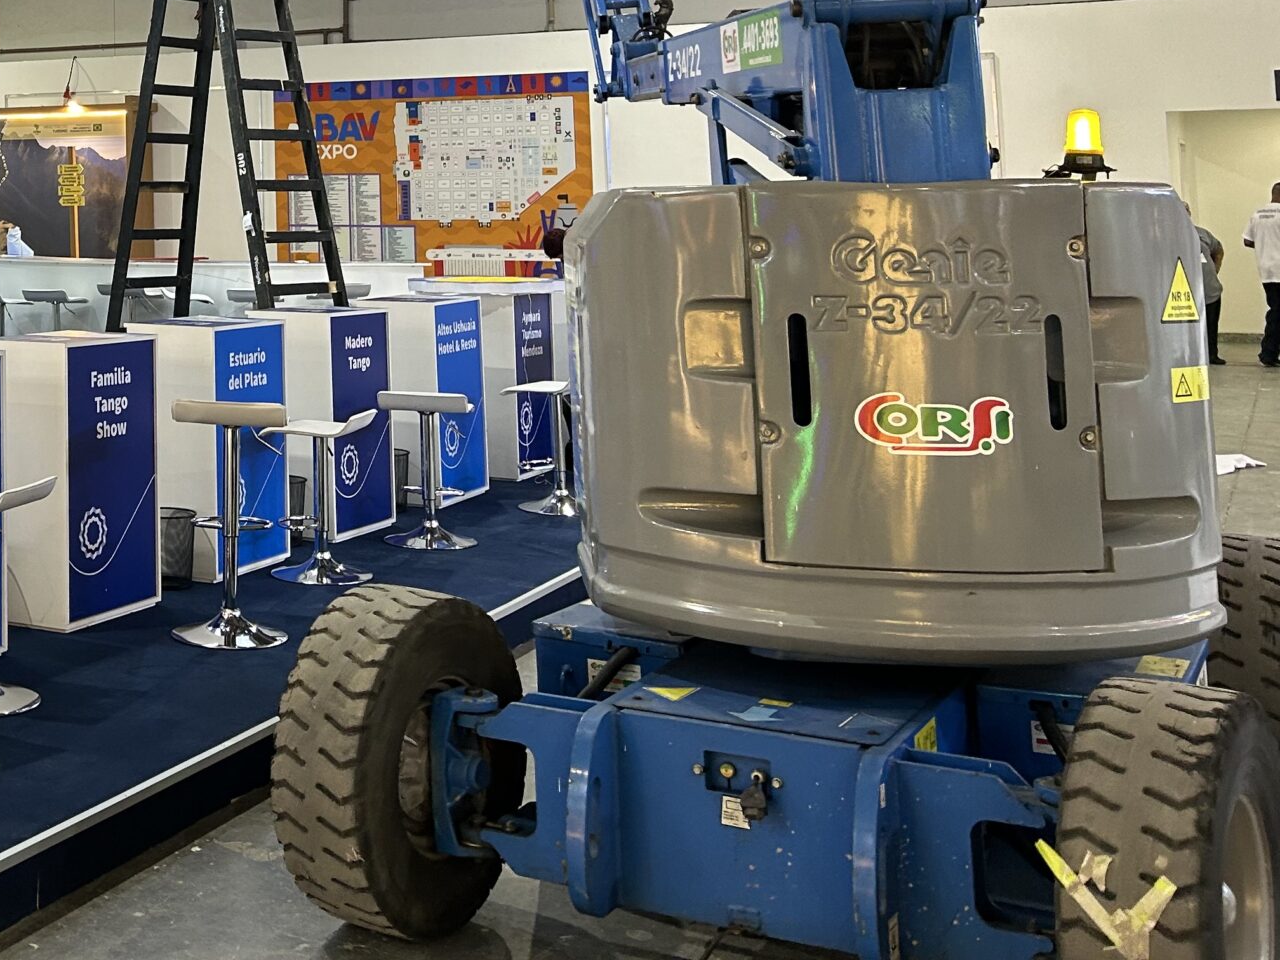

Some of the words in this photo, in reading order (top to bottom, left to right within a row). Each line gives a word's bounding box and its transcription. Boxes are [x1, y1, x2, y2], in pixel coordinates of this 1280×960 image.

[667, 44, 701, 82] Z-34/22
[288, 111, 380, 142] BAV
[317, 144, 357, 160] XPO
[1172, 291, 1182, 302] NR
[811, 290, 1044, 339] Z-34/22
[437, 322, 453, 337] Altos
[453, 319, 476, 334] Ushuaia
[345, 334, 373, 350] Madero
[438, 342, 455, 356] Hotel
[455, 341, 461, 351] &
[461, 338, 477, 351] Resto
[229, 348, 266, 368] Estuario
[348, 357, 371, 372] Tango
[90, 366, 132, 388] Familia
[228, 374, 243, 390] del
[244, 372, 268, 388] Plata
[94, 396, 128, 414] Tango
[96, 420, 127, 440] Show
